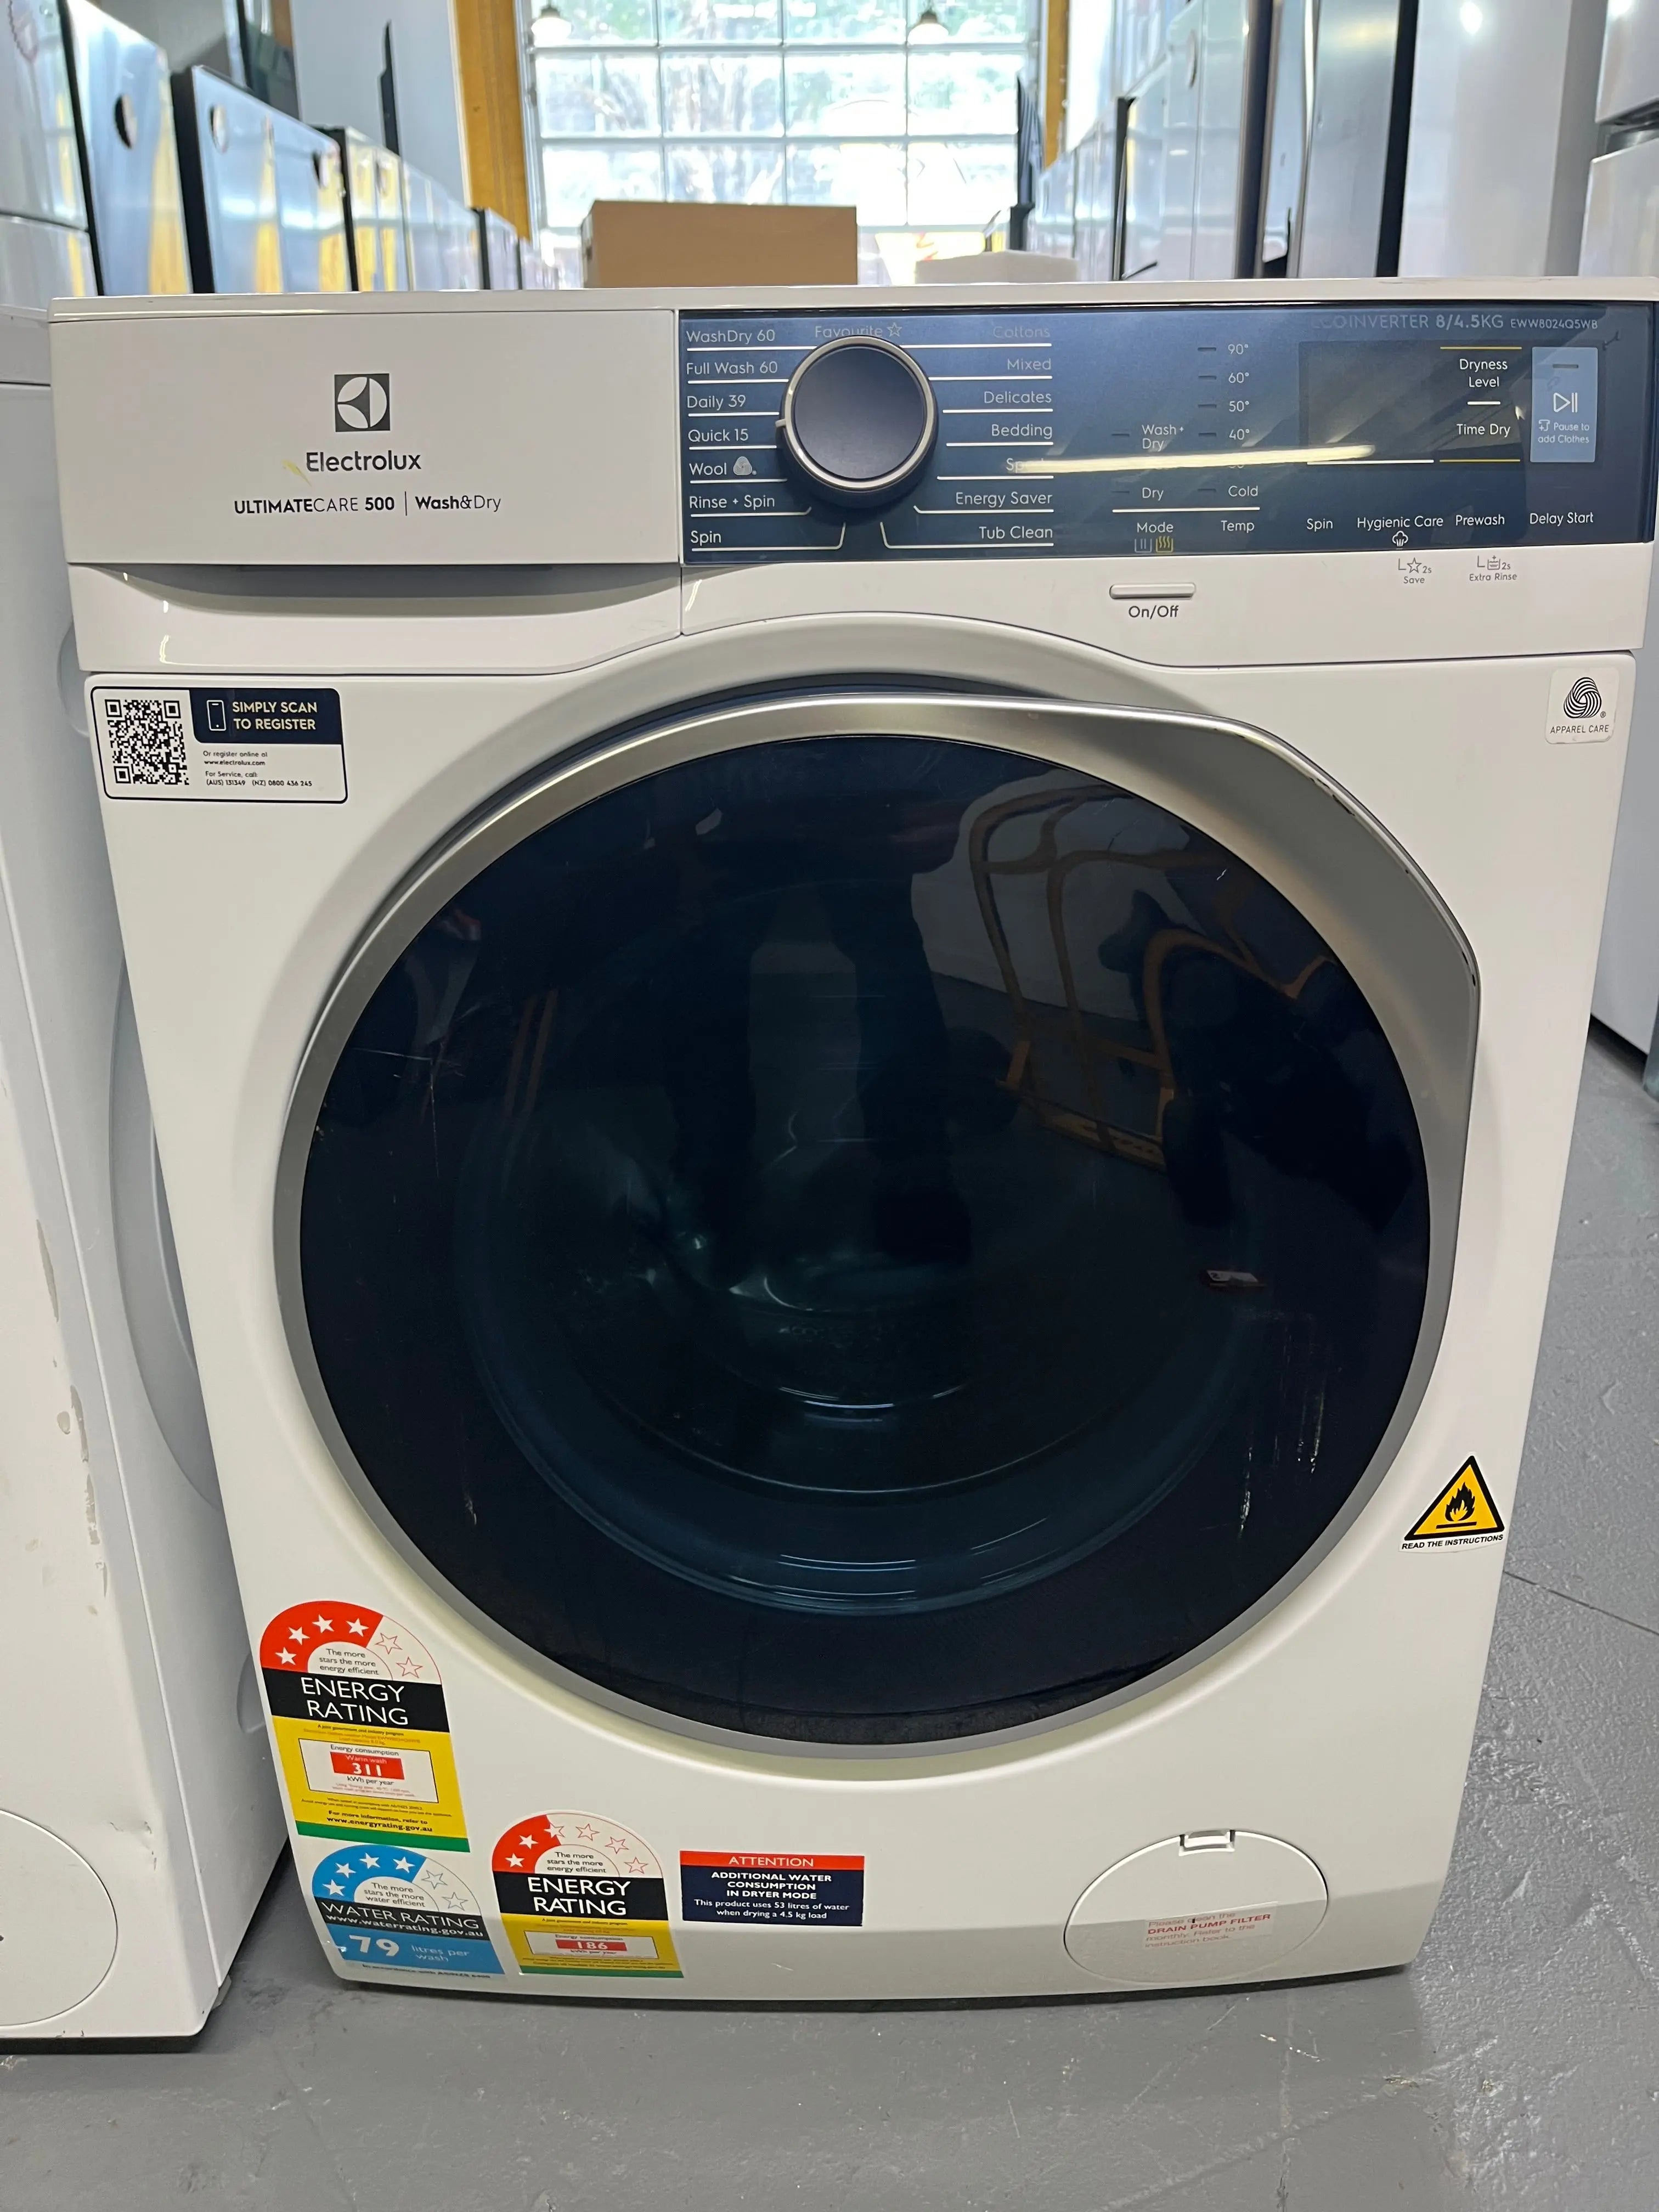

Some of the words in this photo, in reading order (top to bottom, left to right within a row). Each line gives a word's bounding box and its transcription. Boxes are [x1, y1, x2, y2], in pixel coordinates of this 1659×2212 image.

[1435, 314, 1504, 329] 8/4.5KG
[1510, 318, 1598, 330] EWW8024Q5WB
[686, 329, 752, 344] WashDry
[757, 329, 775, 342] 60
[815, 325, 883, 338] Favourite
[992, 325, 1051, 338] Cottons
[686, 362, 710, 375] Full
[715, 362, 754, 374] Wash
[759, 361, 778, 374] 60
[1007, 358, 1052, 371] Mixed
[1459, 358, 1508, 373] Dryness
[1469, 376, 1499, 388] Level
[687, 395, 724, 410] Daily
[729, 394, 746, 408] 39
[984, 390, 1052, 404] Delicates
[991, 424, 1053, 439] Bedding
[1457, 424, 1486, 436] Time
[1489, 424, 1511, 438] Dry
[1553, 422, 1578, 432] Pause
[1580, 422, 1590, 432] to
[688, 428, 731, 442] Quick
[734, 428, 749, 441] 15
[1537, 435, 1556, 444] add
[1558, 434, 1590, 444] Clothes
[1142, 438, 1164, 452] Dry
[306, 450, 422, 472] Electrolux
[689, 462, 727, 476] Wool
[1142, 487, 1164, 501] Dry
[1228, 485, 1259, 498] Cold
[234, 498, 359, 514] ULTIMATECARE
[364, 496, 395, 511] 500
[415, 495, 502, 513] Wash&Dry
[689, 495, 728, 509] Rinse
[743, 494, 776, 510] Spin
[956, 492, 1006, 509] Energy
[1010, 491, 1053, 505] Saver
[1306, 518, 1334, 531] Spin
[1356, 517, 1410, 532] Hygienic
[1414, 515, 1444, 527] Care
[1455, 514, 1505, 527] Prewash
[1529, 512, 1564, 527] Delay
[1566, 511, 1594, 524] Start
[979, 525, 1006, 540] Tub
[1009, 525, 1053, 539] Clean
[1136, 521, 1174, 534] Mode
[1221, 520, 1255, 533] Temp
[690, 530, 722, 545] Spin
[1422, 566, 1432, 574] 2s
[1501, 562, 1511, 570] 2s
[1403, 576, 1425, 584] Save
[1469, 573, 1491, 582] Extra
[1494, 572, 1518, 581] Rinse
[1128, 605, 1180, 620] On/Off
[232, 702, 278, 714] SIMPLY
[280, 701, 318, 713] SCAN
[233, 718, 251, 730] TO
[255, 718, 317, 730] REGISTER
[1549, 725, 1586, 734] APPAREL
[1588, 724, 1610, 733] CARE
[1402, 1542, 1425, 1550] READ
[1444, 1534, 1504, 1546] INSTRUCTIONS
[326, 1648, 342, 1656] The
[343, 1650, 366, 1658] more
[319, 1664, 346, 1674] energy
[348, 1667, 380, 1676] efficient
[300, 1676, 405, 1703] ENERGY
[306, 1700, 409, 1726] RATING
[330, 1743, 353, 1753] Energy
[355, 1747, 399, 1757] consumption
[345, 1754, 368, 1763] Warm
[352, 1762, 382, 1777] 311
[326, 1816, 433, 1833] www.energyrating.gov.au
[728, 1855, 815, 1867] ATTENTION
[711, 1871, 786, 1881] ADDITIONAL
[788, 1874, 832, 1882] WATER
[371, 1882, 390, 1891] The
[391, 1885, 414, 1893] more
[527, 1877, 631, 1897] ENERGY
[727, 1881, 816, 1891] CONSUMPTION
[363, 1888, 384, 1898] stars
[385, 1889, 400, 1899] the
[401, 1893, 425, 1901] more
[365, 1895, 391, 1904] water
[392, 1898, 426, 1908] efficient
[742, 1891, 780, 1899] DRYER
[782, 1892, 817, 1900] MODE
[533, 1896, 627, 1916] RATING
[694, 1898, 713, 1906] This
[715, 1900, 751, 1910] product
[321, 1901, 399, 1922] WATER
[400, 1912, 479, 1929] RATING
[743, 1910, 770, 1919] drying
[795, 1911, 806, 1920] kg
[1148, 1917, 1184, 1927] Please
[325, 1913, 484, 1938] www.waterrating.gov.au
[1148, 1925, 1186, 1935] DRAIN
[1190, 1920, 1227, 1930] PUMP
[1230, 1913, 1271, 1925] FILTER
[348, 1934, 400, 1957] 79
[577, 1941, 608, 1950] 186
[1144, 1938, 1200, 1948] instruction
[1202, 1934, 1230, 1943] book
[411, 1944, 446, 1957] litres
[447, 1948, 470, 1958] per
[415, 1953, 449, 1963] wash
